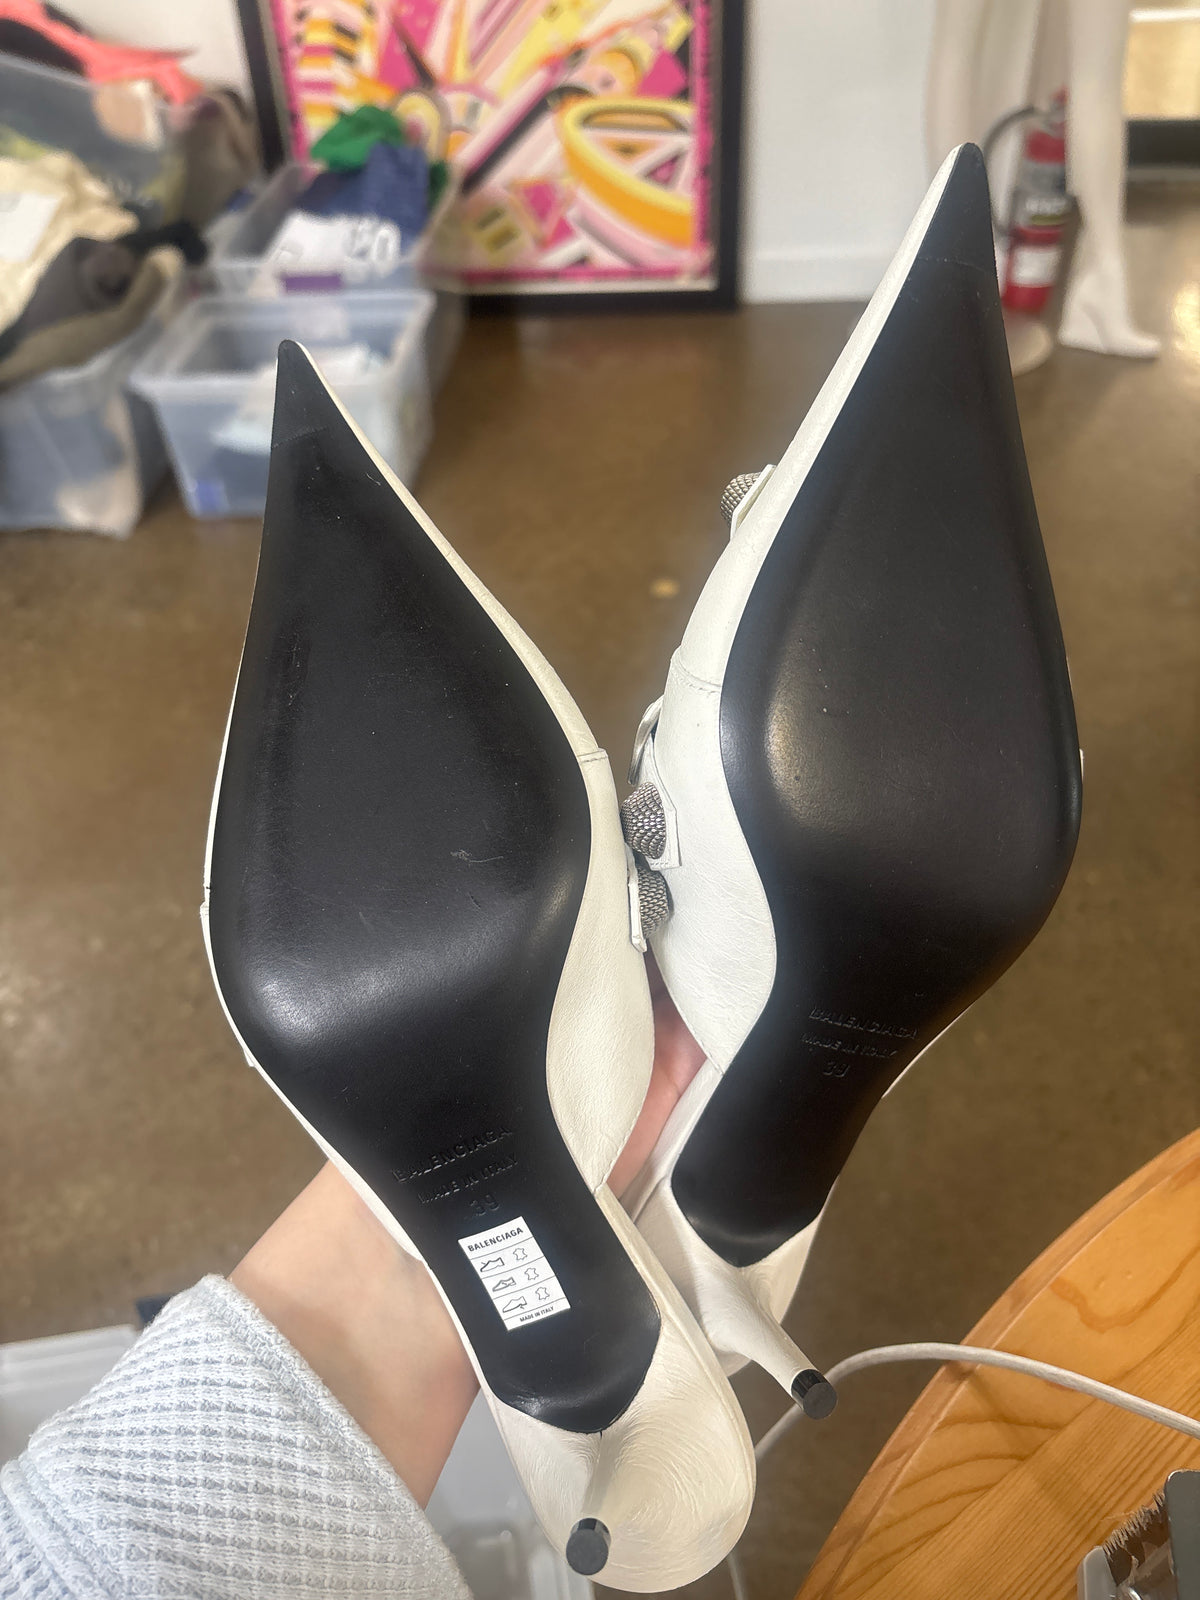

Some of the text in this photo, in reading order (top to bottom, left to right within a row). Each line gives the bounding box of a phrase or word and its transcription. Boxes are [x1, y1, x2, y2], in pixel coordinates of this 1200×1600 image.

[470, 1194, 500, 1217] 39
[467, 1227, 524, 1252] BALENCIAGA
[520, 1312, 534, 1322] MADE
[541, 1306, 554, 1316] ITALY
